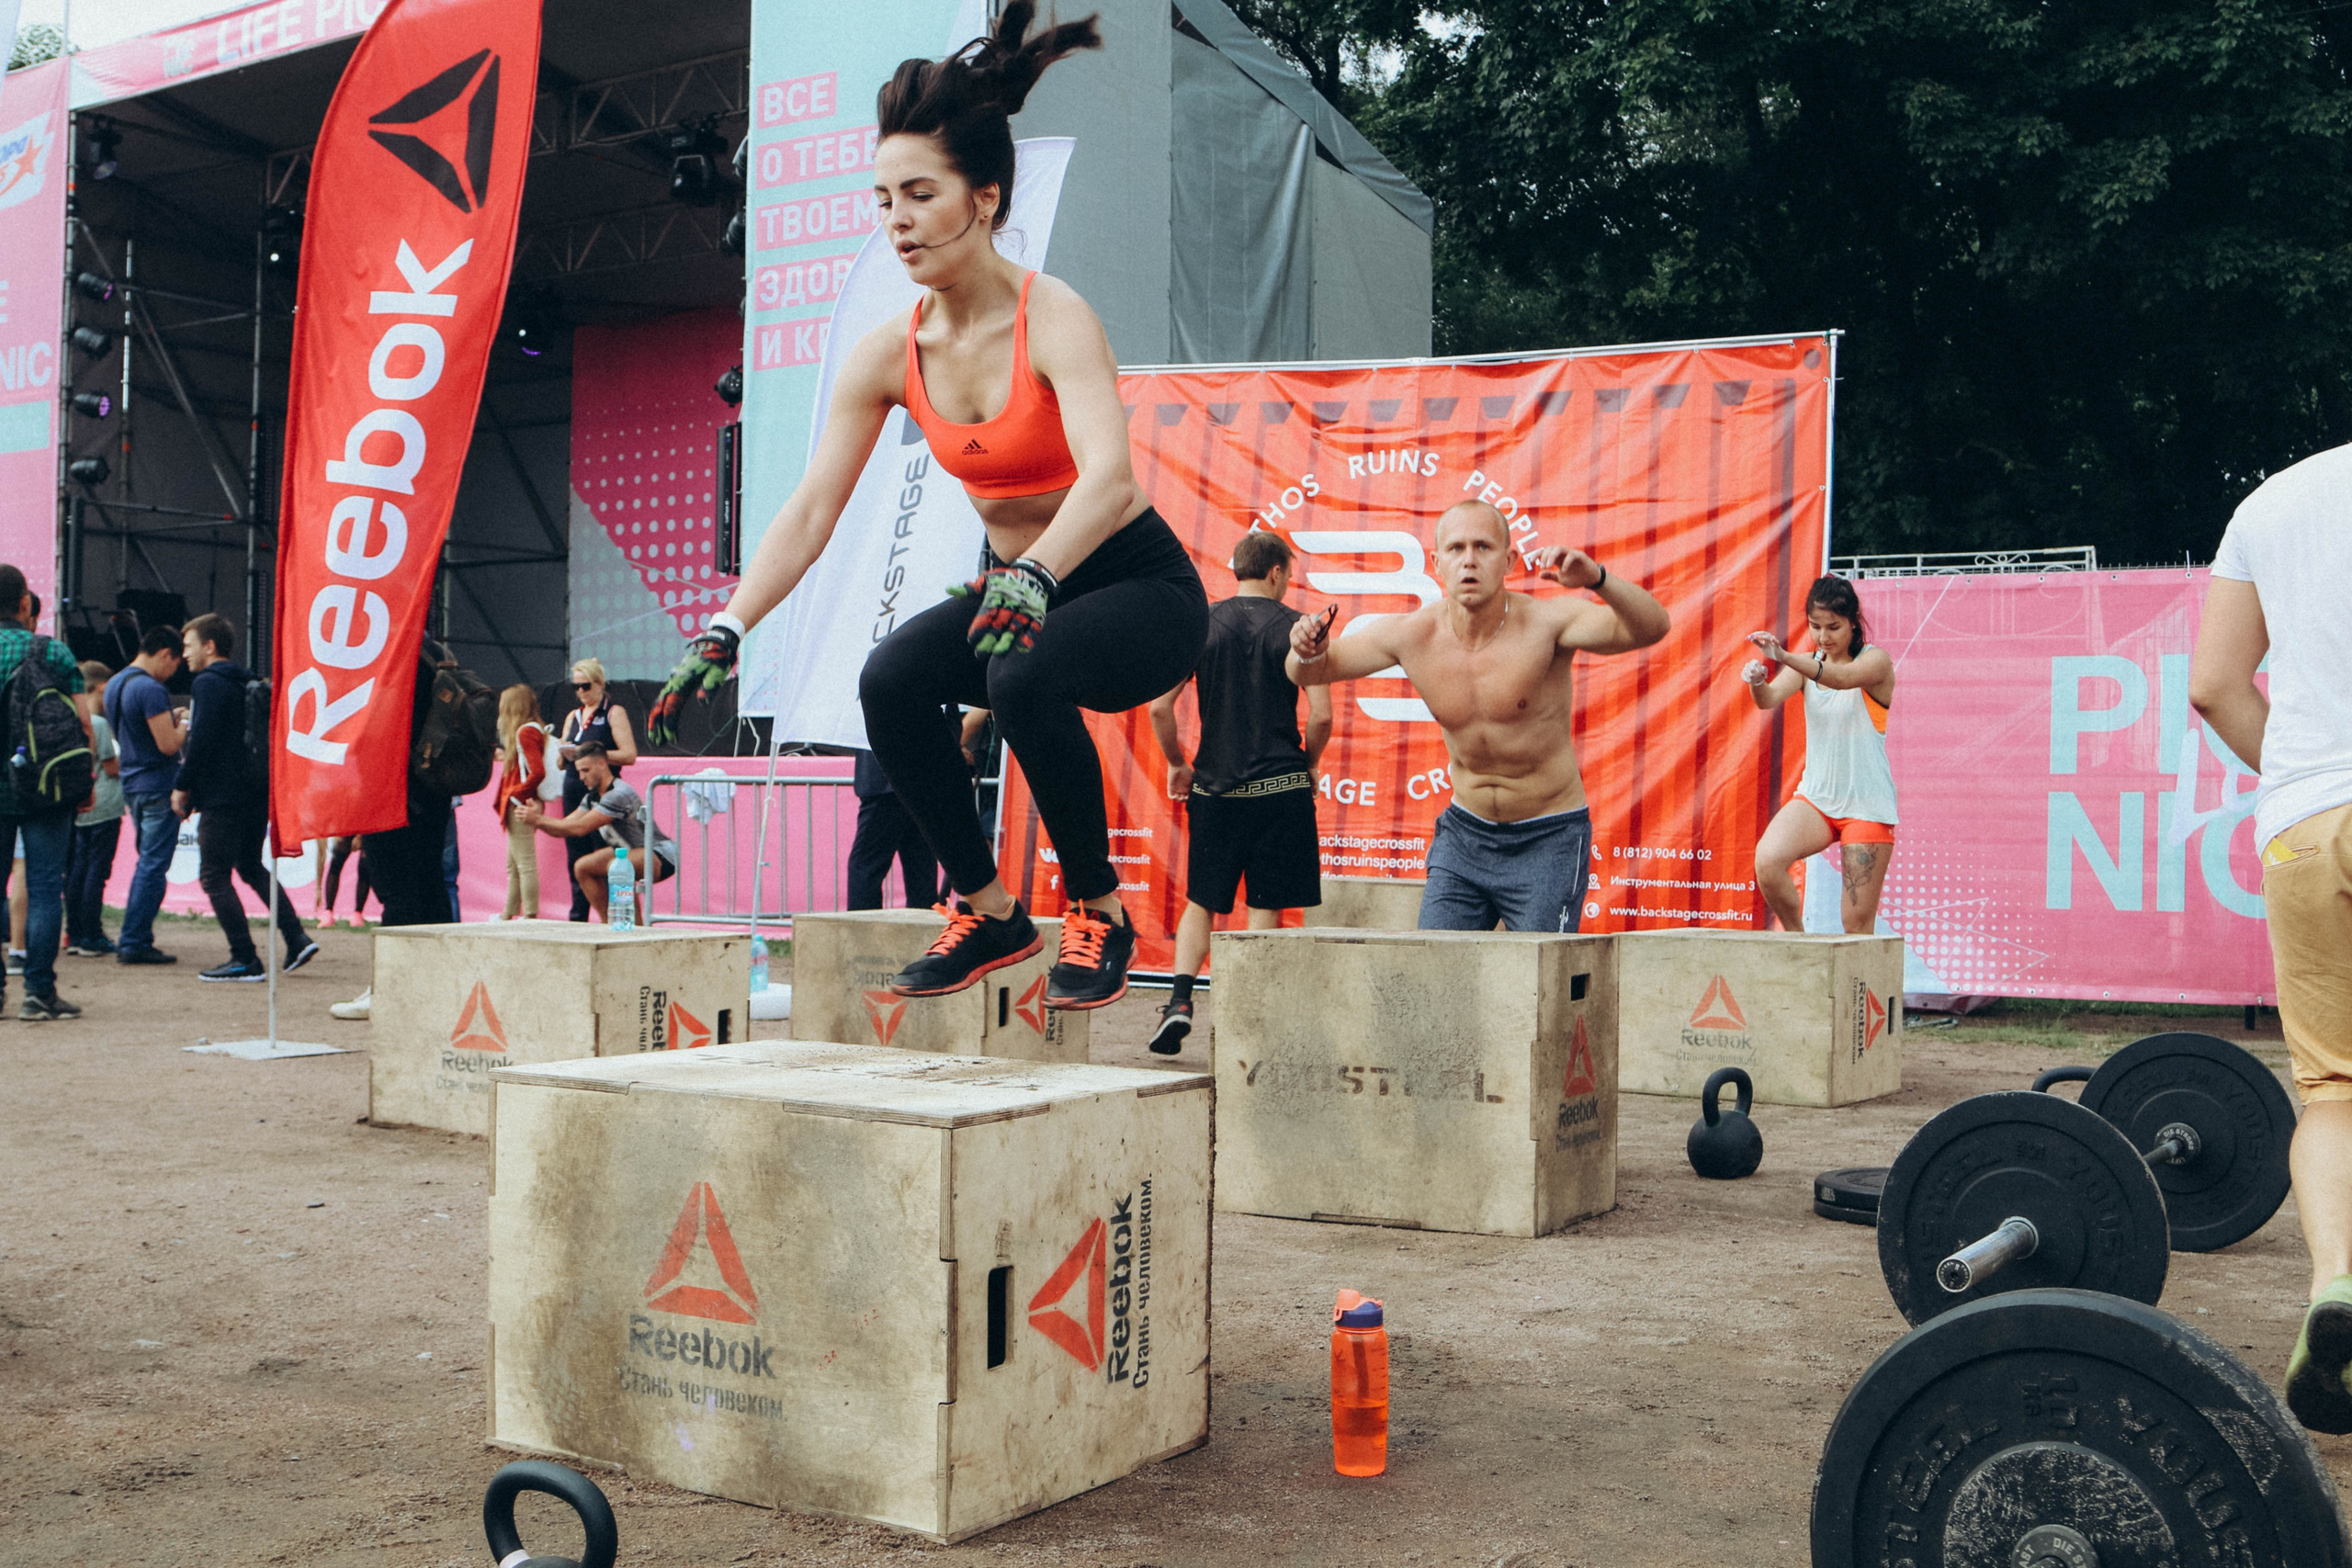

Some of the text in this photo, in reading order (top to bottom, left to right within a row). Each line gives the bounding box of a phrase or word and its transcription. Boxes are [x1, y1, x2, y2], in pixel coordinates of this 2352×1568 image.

[216, 1, 302, 63] LIFE
[763, 77, 831, 123] ВСЕ
[763, 129, 879, 182] О ТЕБЕ
[761, 192, 881, 243] ТВОЕМ
[761, 329, 782, 366] И
[1347, 448, 1441, 479] RUINS
[286, 238, 474, 765] Reebok
[1407, 762, 1452, 801] CR
[1612, 846, 1712, 861] 8 (812) 904 66 02
[1610, 875, 1756, 893] Инструментальная улица 3
[1609, 906, 1753, 921] www.backstagecrossfit.ru
[1680, 1028, 1753, 1050] Reebok
[1857, 981, 1866, 1059] Reebok
[1107, 1191, 1133, 1384] Reebok
[628, 1314, 777, 1380] Reebok
[1133, 1321, 1149, 1389] Стань
[619, 1359, 674, 1399] Стань
[2052, 1537, 2075, 1555] DIE
